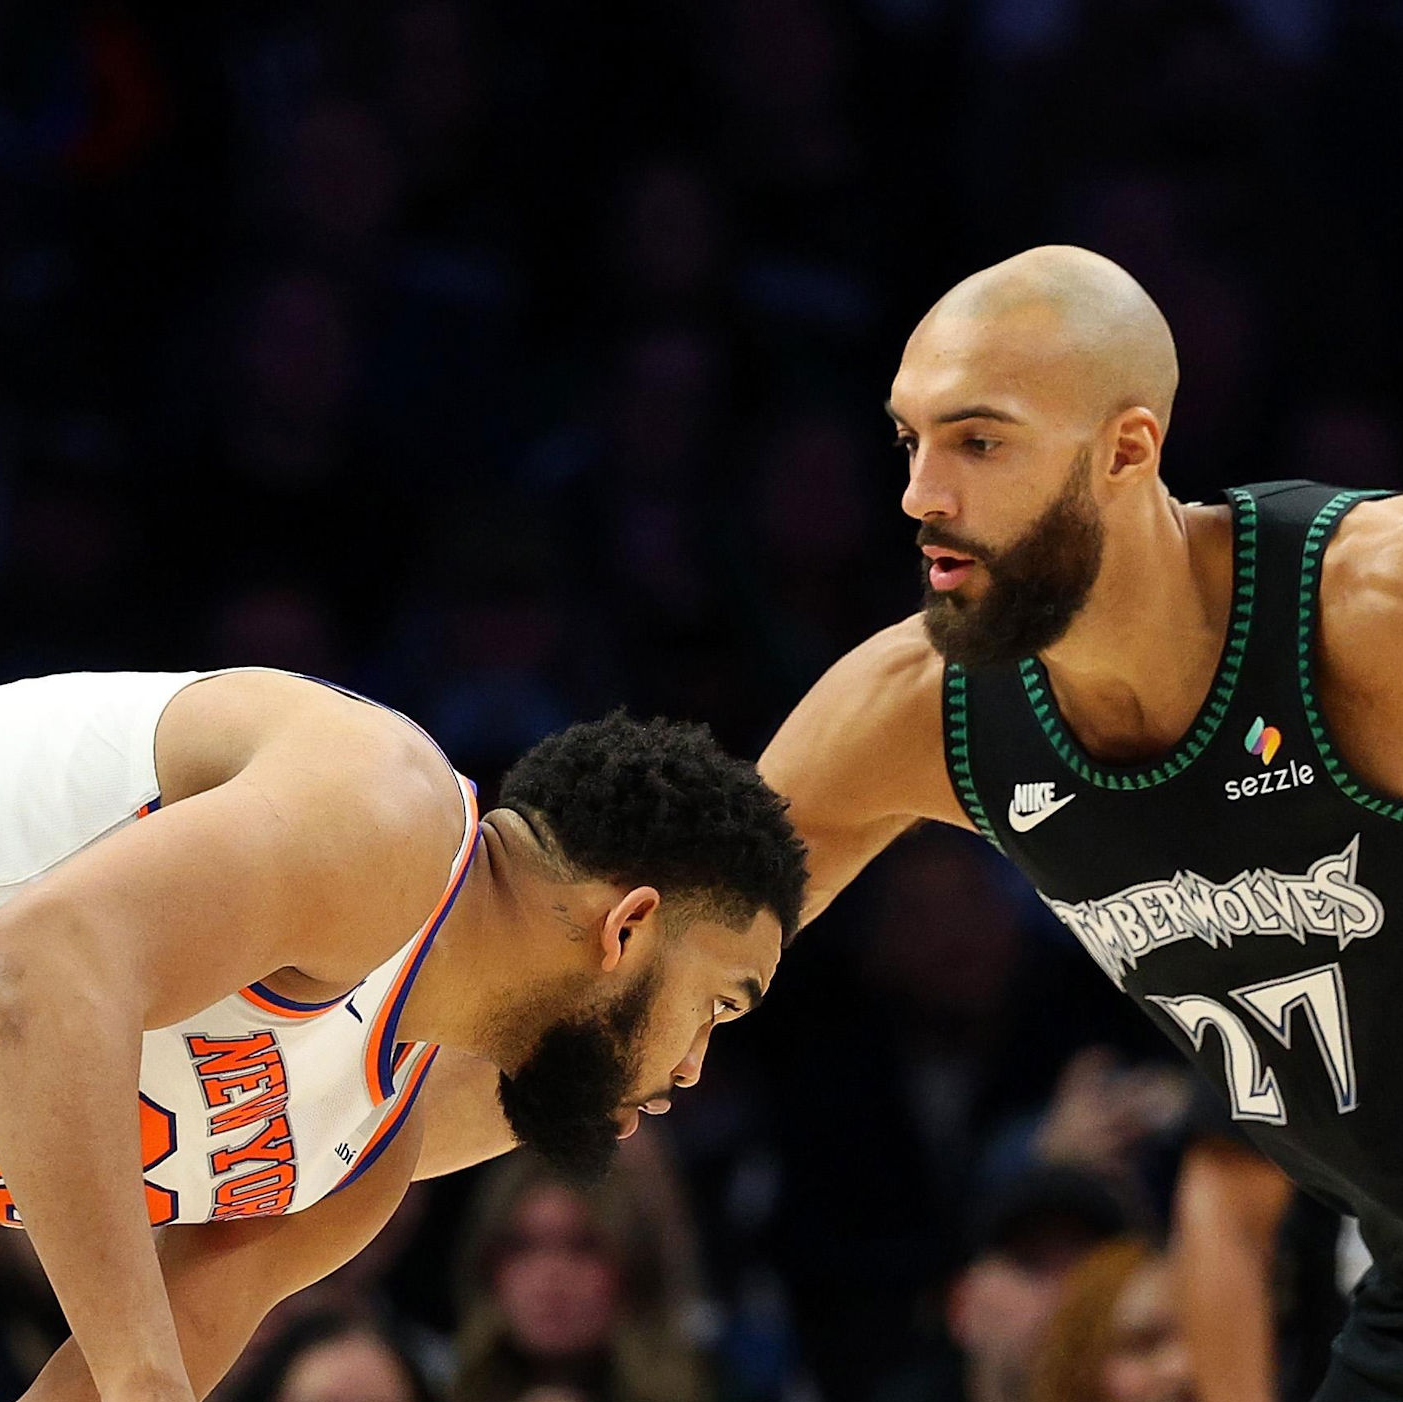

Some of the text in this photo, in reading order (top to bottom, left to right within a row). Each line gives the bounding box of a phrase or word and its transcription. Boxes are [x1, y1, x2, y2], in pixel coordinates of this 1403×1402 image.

[1014, 781, 1056, 813] NIKE
[1224, 759, 1315, 801] sezzle
[1144, 961, 1360, 1126] 27
[182, 1027, 299, 1222] NEW YOR
